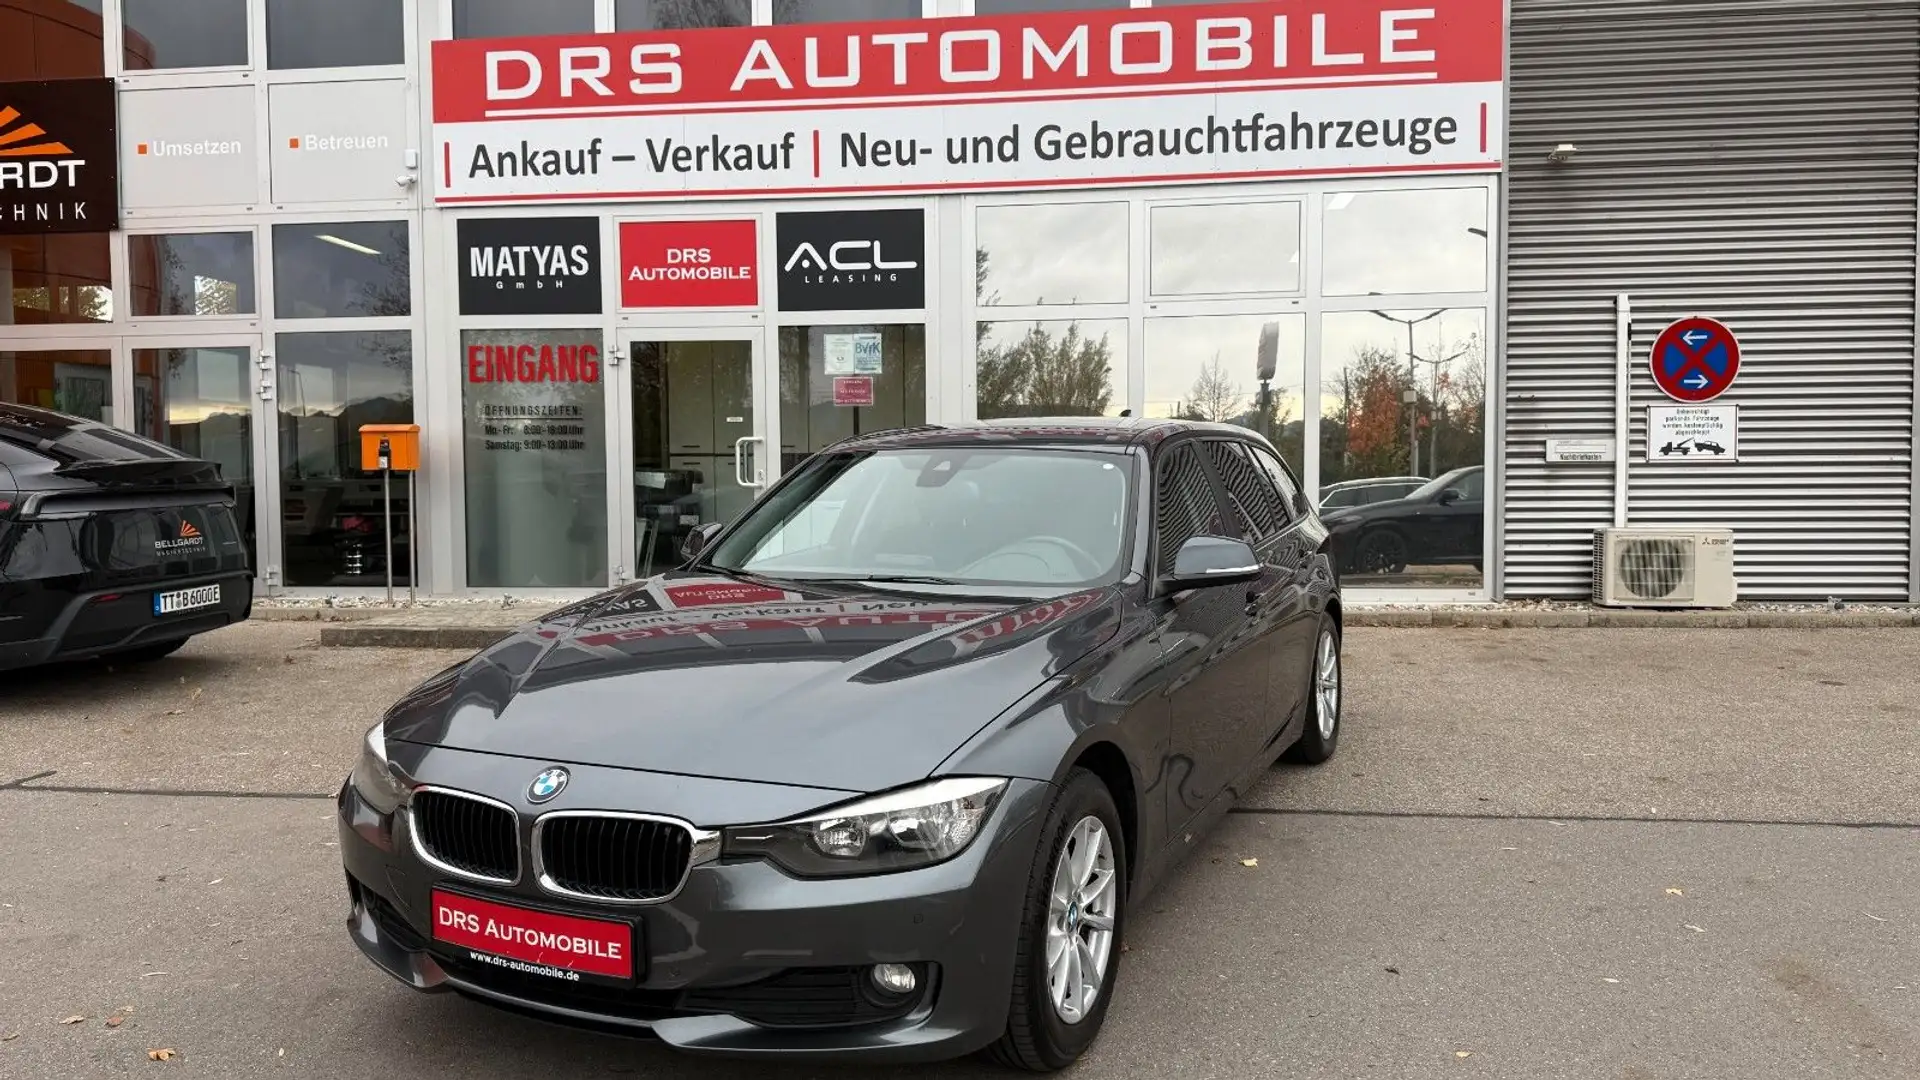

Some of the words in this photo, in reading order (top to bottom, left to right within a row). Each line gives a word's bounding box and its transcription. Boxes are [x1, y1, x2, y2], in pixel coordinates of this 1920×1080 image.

[485, 43, 683, 101] DRS
[729, 8, 1435, 92] AUTOMOBILE
[152, 140, 242, 156] Umsetzen
[305, 134, 388, 151] Betreuen
[468, 138, 601, 178] Ankauf
[645, 132, 795, 173] Verkauf
[840, 131, 932, 168] Neu-
[946, 124, 1019, 164] und
[1034, 111, 1457, 161] Gebrauchtfahrzeuge
[470, 244, 589, 277] MATYAS
[667, 247, 712, 264] DRS
[784, 240, 918, 272] ACL
[496, 280, 563, 289] GmbH
[628, 265, 752, 281] AUTOMOBILE
[805, 273, 898, 283] LEASING
[468, 344, 600, 384] EINGANG
[154, 537, 204, 549] BELLGARDT
[439, 906, 480, 934] DRS
[484, 918, 622, 960] AUTOMOBILE
[470, 951, 580, 982] www.drs-automobile.de
